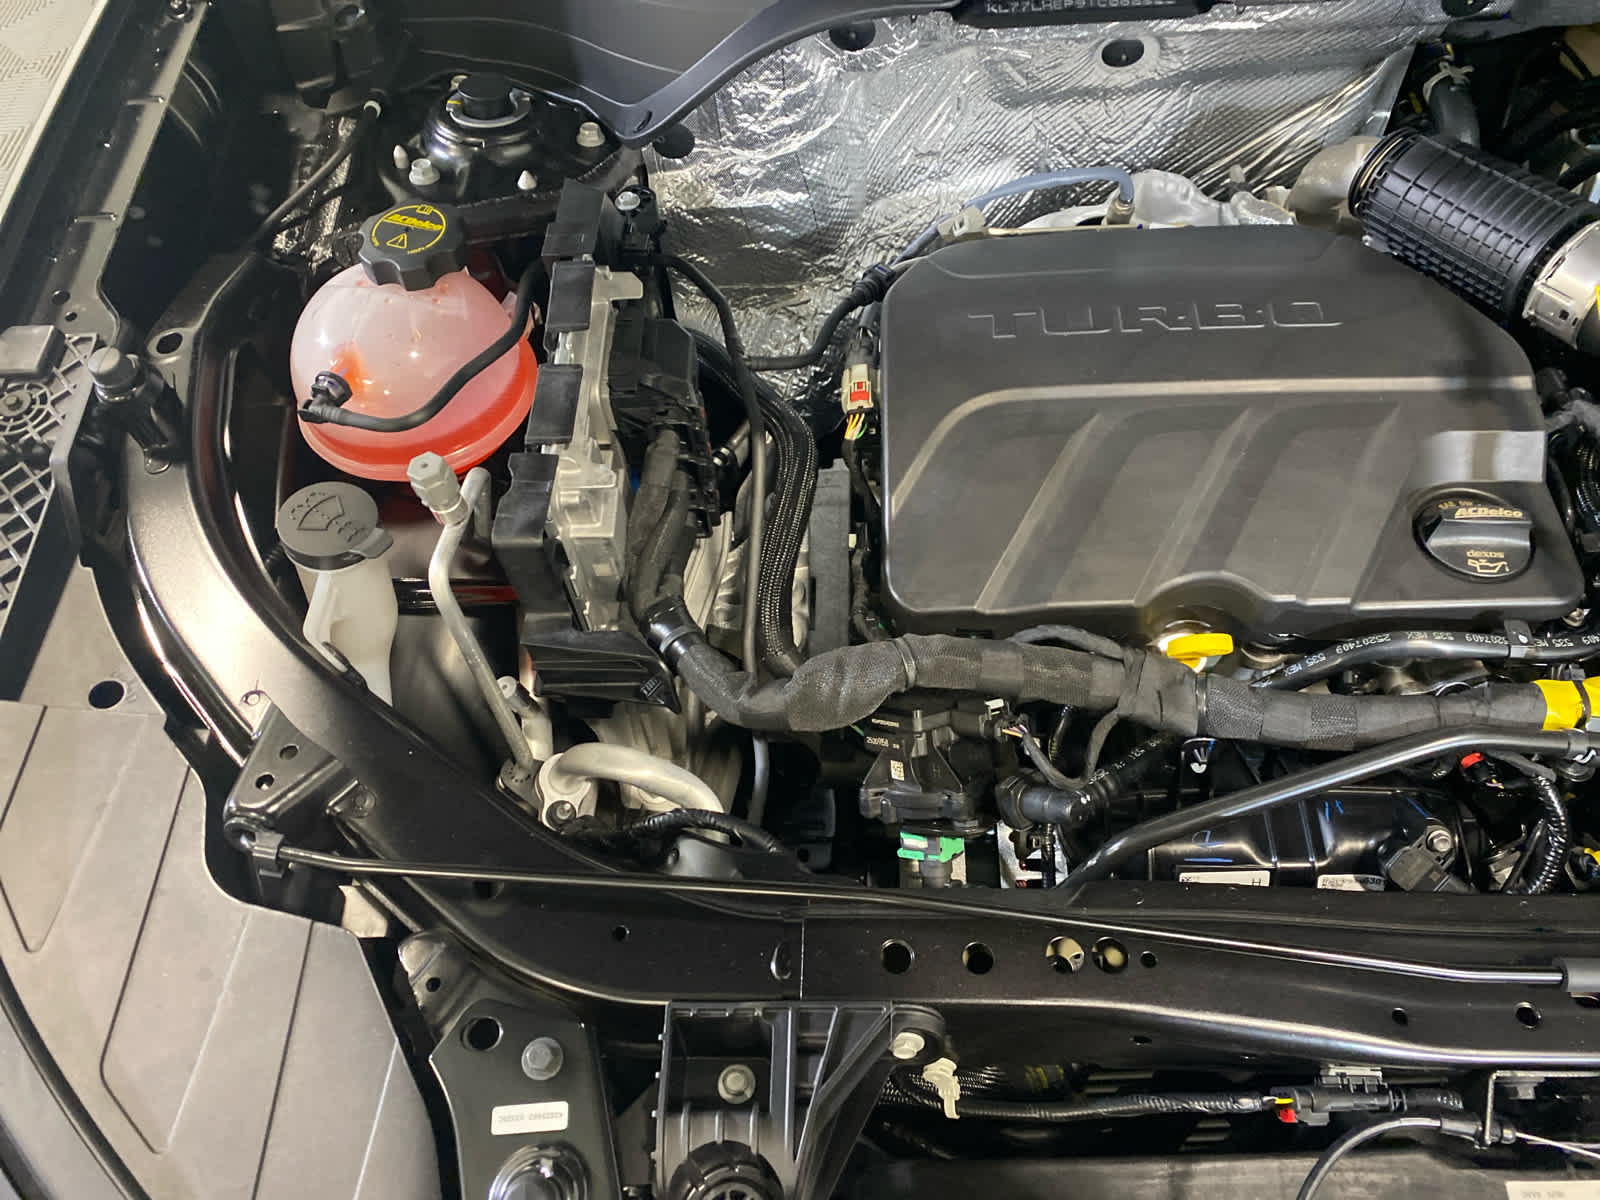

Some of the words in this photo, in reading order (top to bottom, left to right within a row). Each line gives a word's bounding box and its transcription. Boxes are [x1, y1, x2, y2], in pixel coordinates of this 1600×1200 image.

[967, 301, 1342, 338] TURBO
[1454, 507, 1524, 519] ACDelco
[1335, 633, 1392, 654] 25207409
[1465, 633, 1509, 645] 5207409
[1305, 652, 1326, 667] 535
